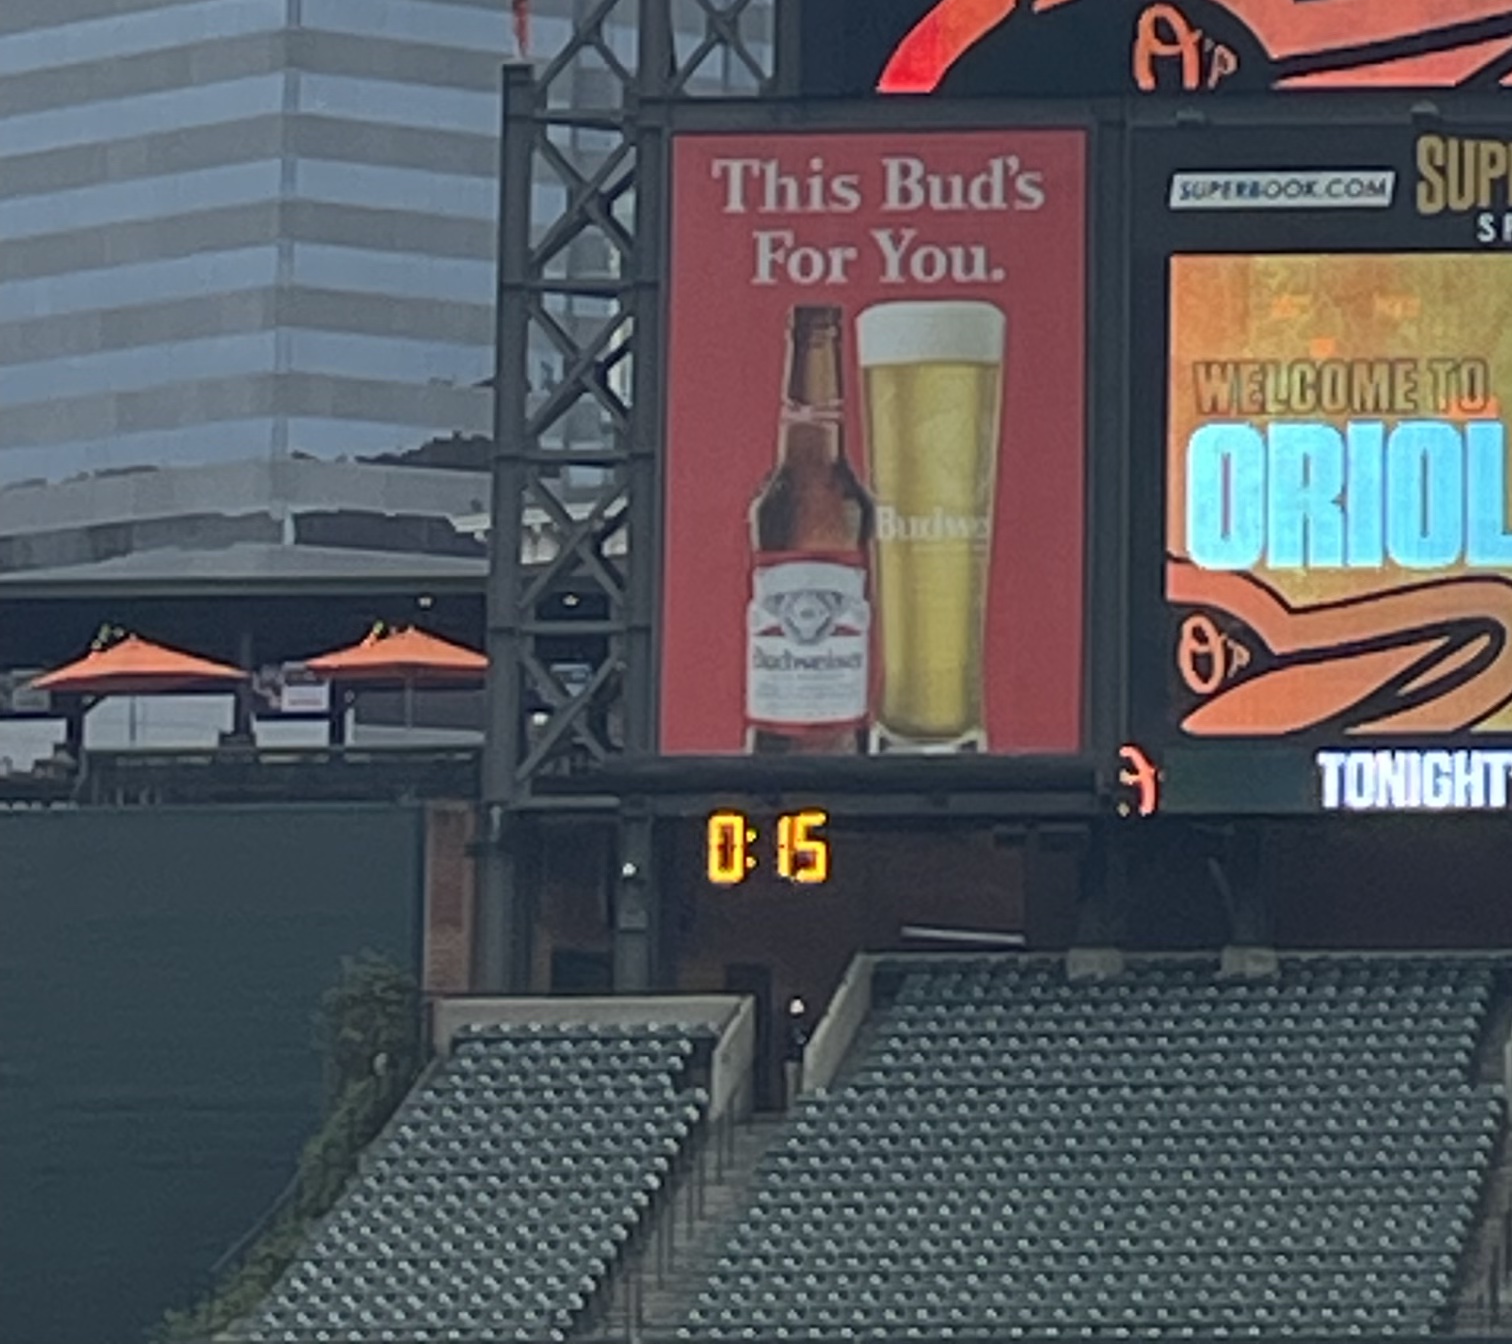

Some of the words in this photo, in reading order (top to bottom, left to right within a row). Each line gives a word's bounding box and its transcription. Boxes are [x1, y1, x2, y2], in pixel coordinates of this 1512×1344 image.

[711, 157, 861, 214] This
[879, 154, 1046, 211] Bud's
[1179, 177, 1387, 201] SUPERBOOK.COM
[751, 230, 858, 285] For
[870, 228, 1007, 283] You.
[1193, 358, 1418, 416] WELCOME
[1429, 358, 1490, 413] TO
[707, 813, 829, 884] 0:15
